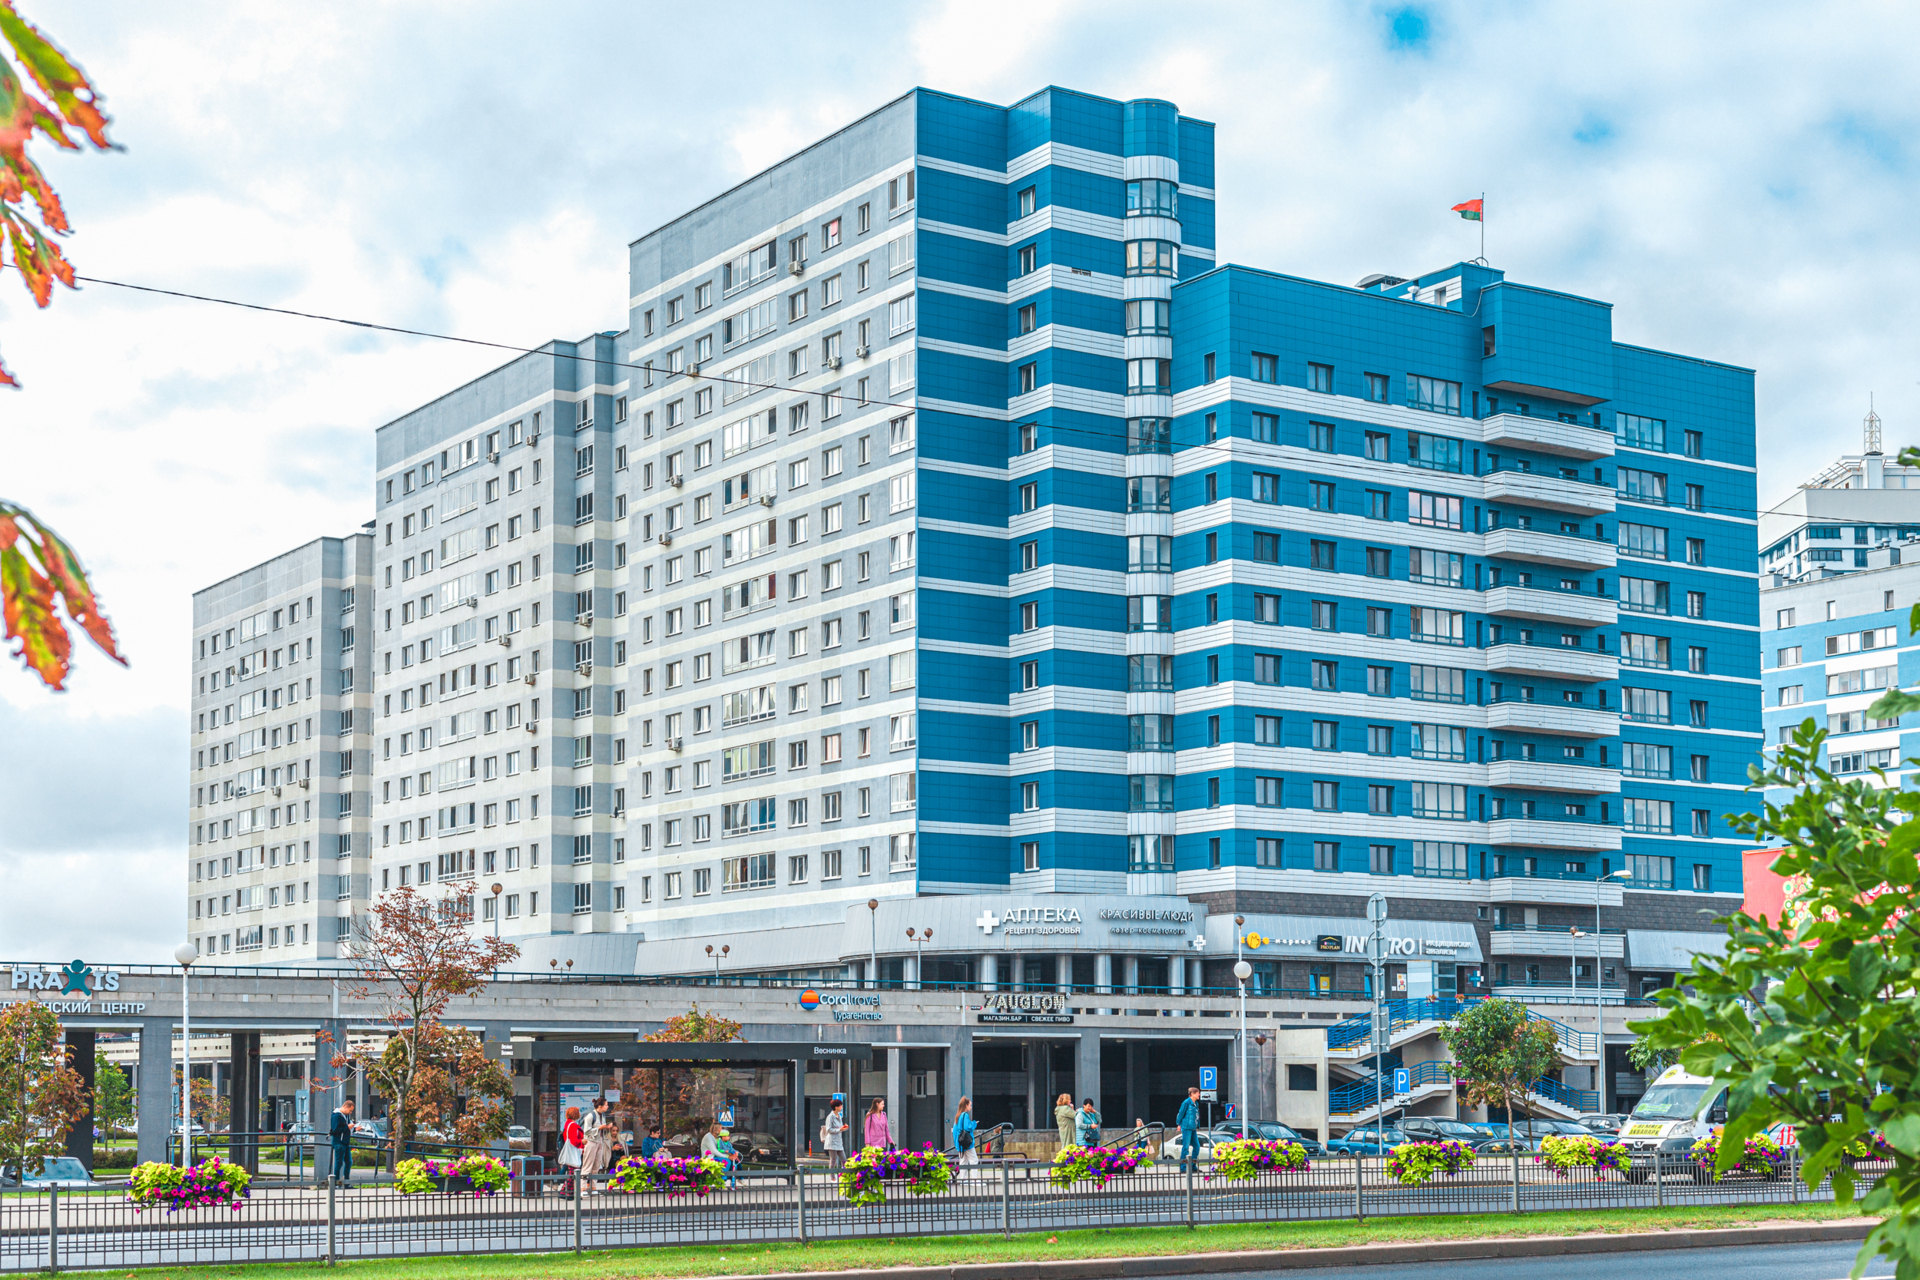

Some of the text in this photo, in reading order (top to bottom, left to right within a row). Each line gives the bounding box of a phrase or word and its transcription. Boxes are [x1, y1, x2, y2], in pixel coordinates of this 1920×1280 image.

[1003, 907, 1082, 923] АПТЕКА
[1100, 909, 1195, 922] КРАСИВЫЕ ЛЮДИ
[1004, 927, 1081, 935] РЕЦЕПТ ЗДОРОВЬЯ
[1344, 935, 1416, 956] INRO
[101, 1002, 146, 1016] ЦЕНТР
[984, 994, 1065, 1010] ZAUGLOM
[834, 1010, 883, 1021] Турагентство
[573, 1045, 607, 1054] Веснінка
[813, 1046, 847, 1055] Веснинка
[1203, 1069, 1213, 1087] P
[1397, 1071, 1407, 1090] P
